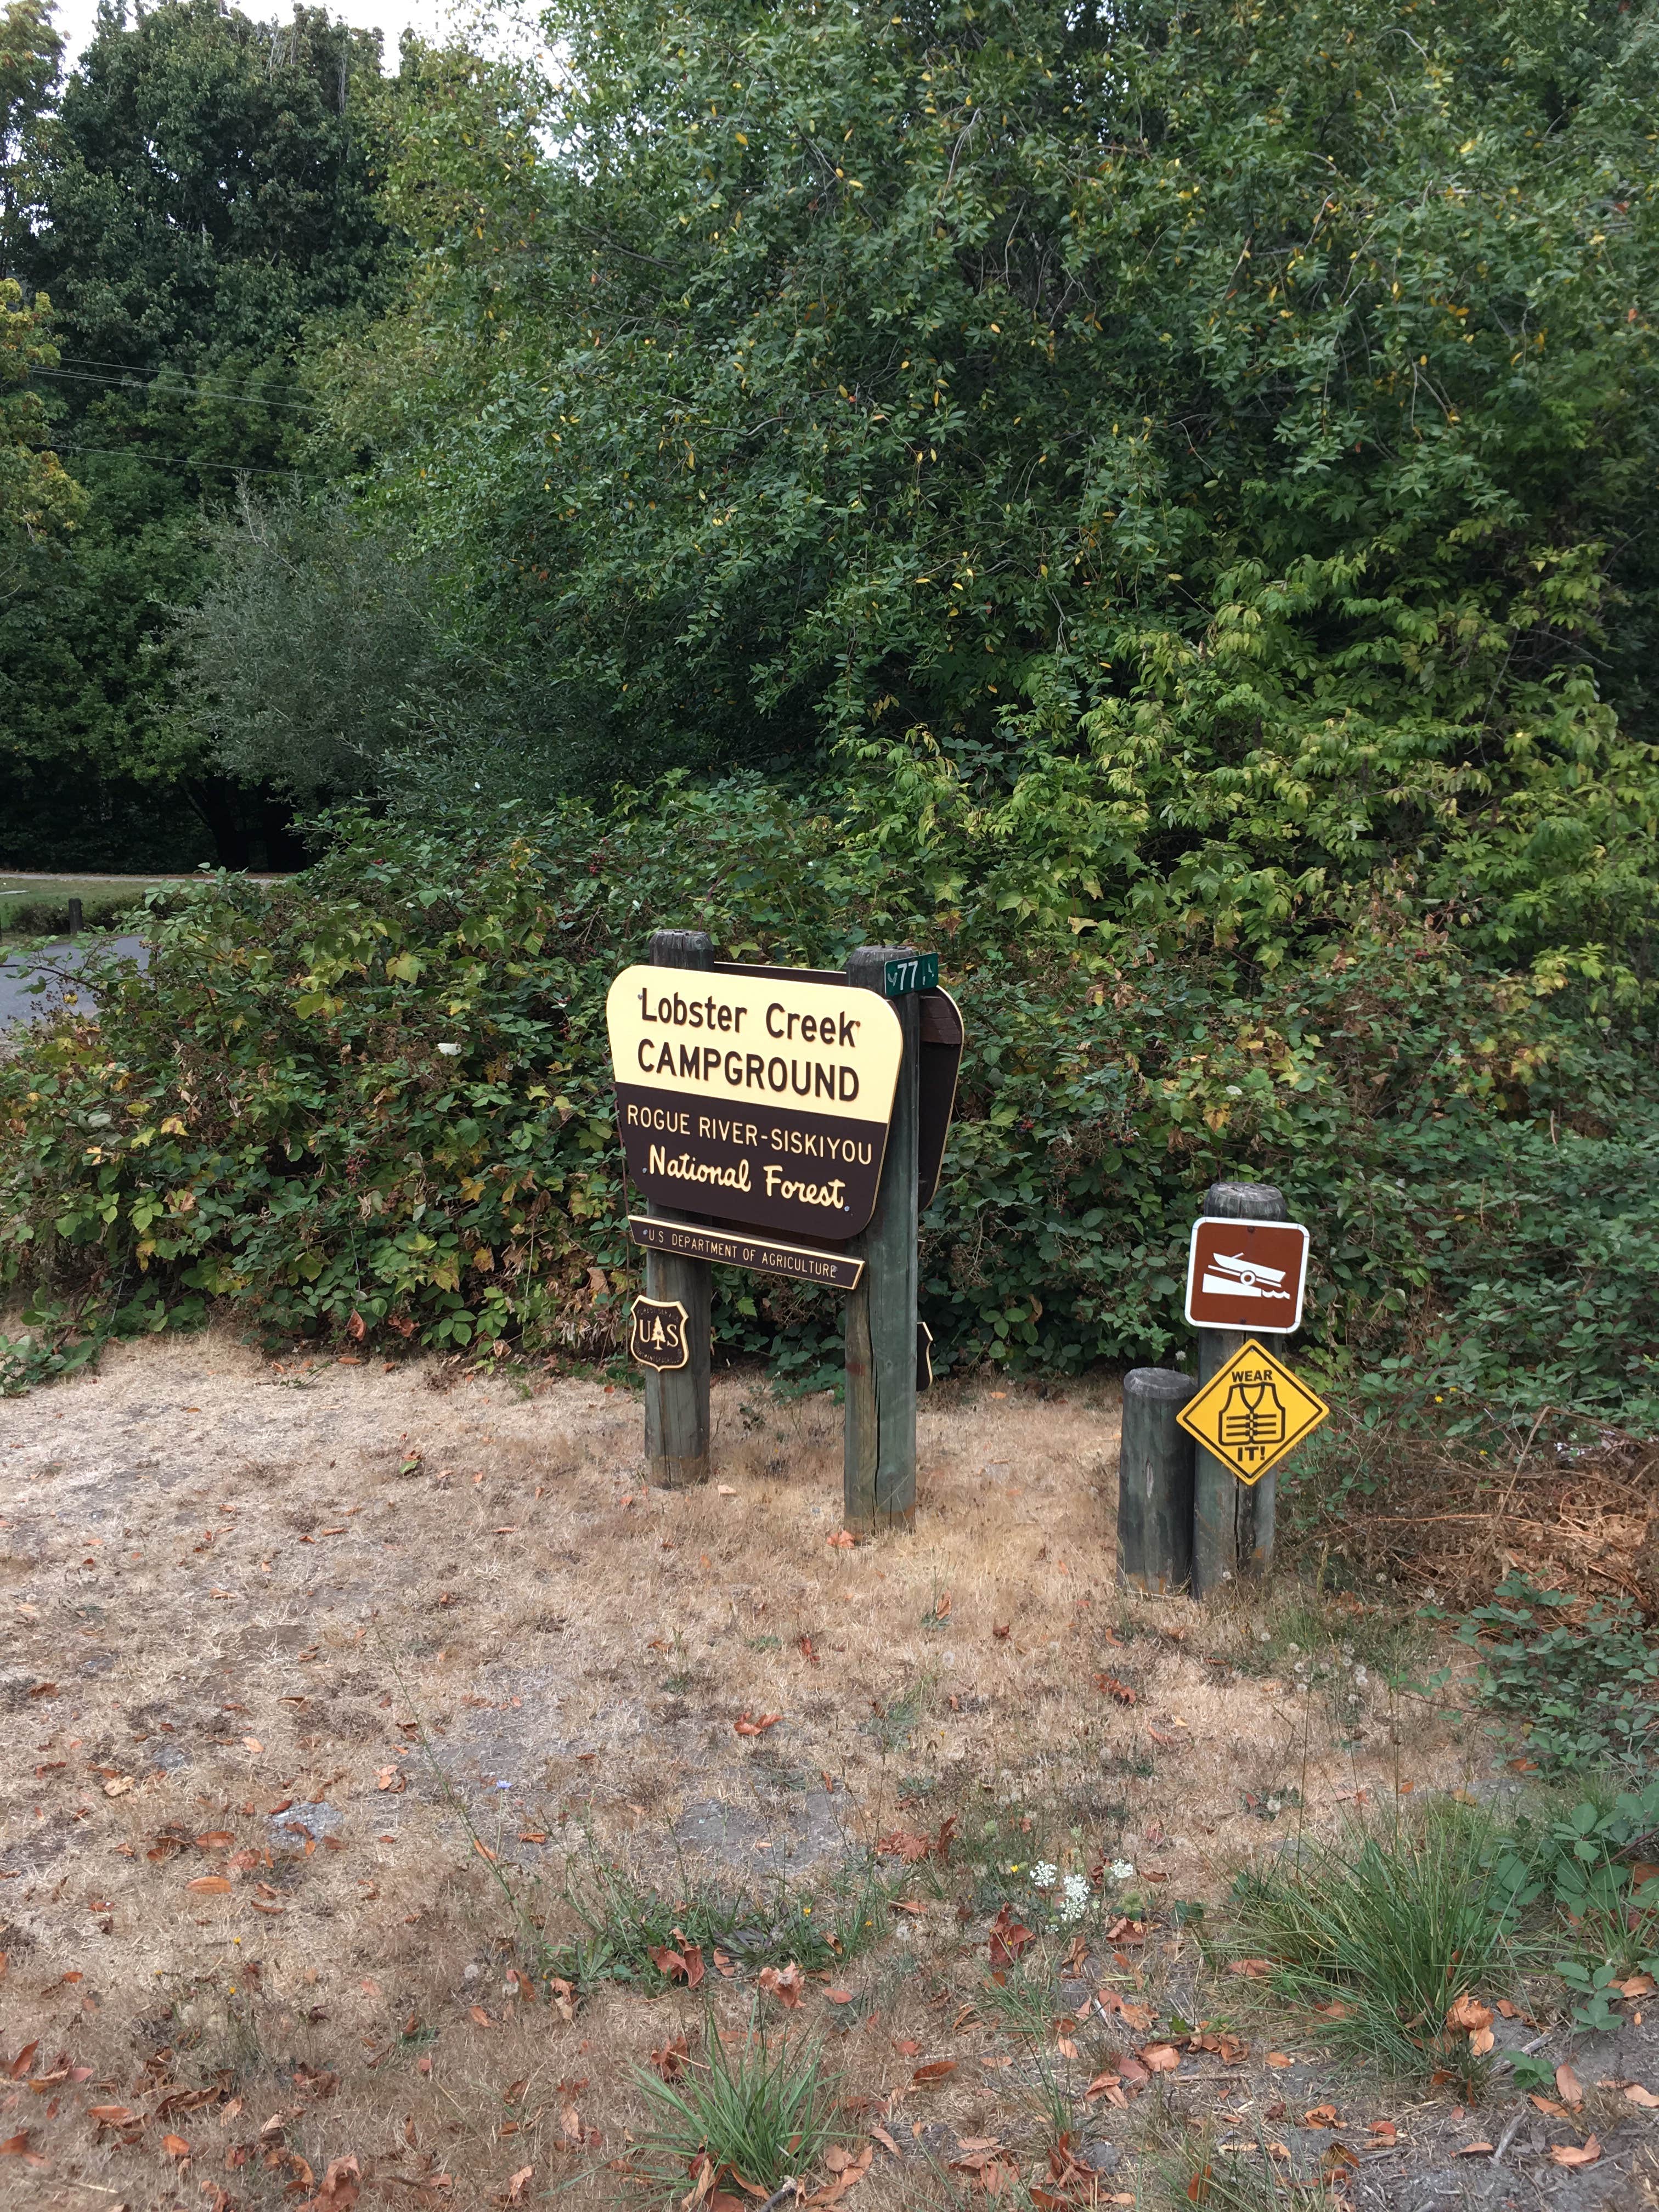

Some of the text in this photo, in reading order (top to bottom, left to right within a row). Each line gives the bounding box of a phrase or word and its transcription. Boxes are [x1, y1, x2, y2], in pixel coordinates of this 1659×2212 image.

[641, 987, 856, 1048] Lobster Creek
[637, 1039, 859, 1102] CAMPGROUND
[628, 1104, 872, 1165] ROGUE RIVER-SISKIYOU
[650, 1144, 845, 1209] National Forest
[672, 1233, 737, 1259] DEPARTMENT
[743, 1248, 756, 1262] OF
[761, 1251, 838, 1278] AGRICULTURE
[1231, 1369, 1273, 1383] WEAR
[1237, 1446, 1266, 1462] IT!
